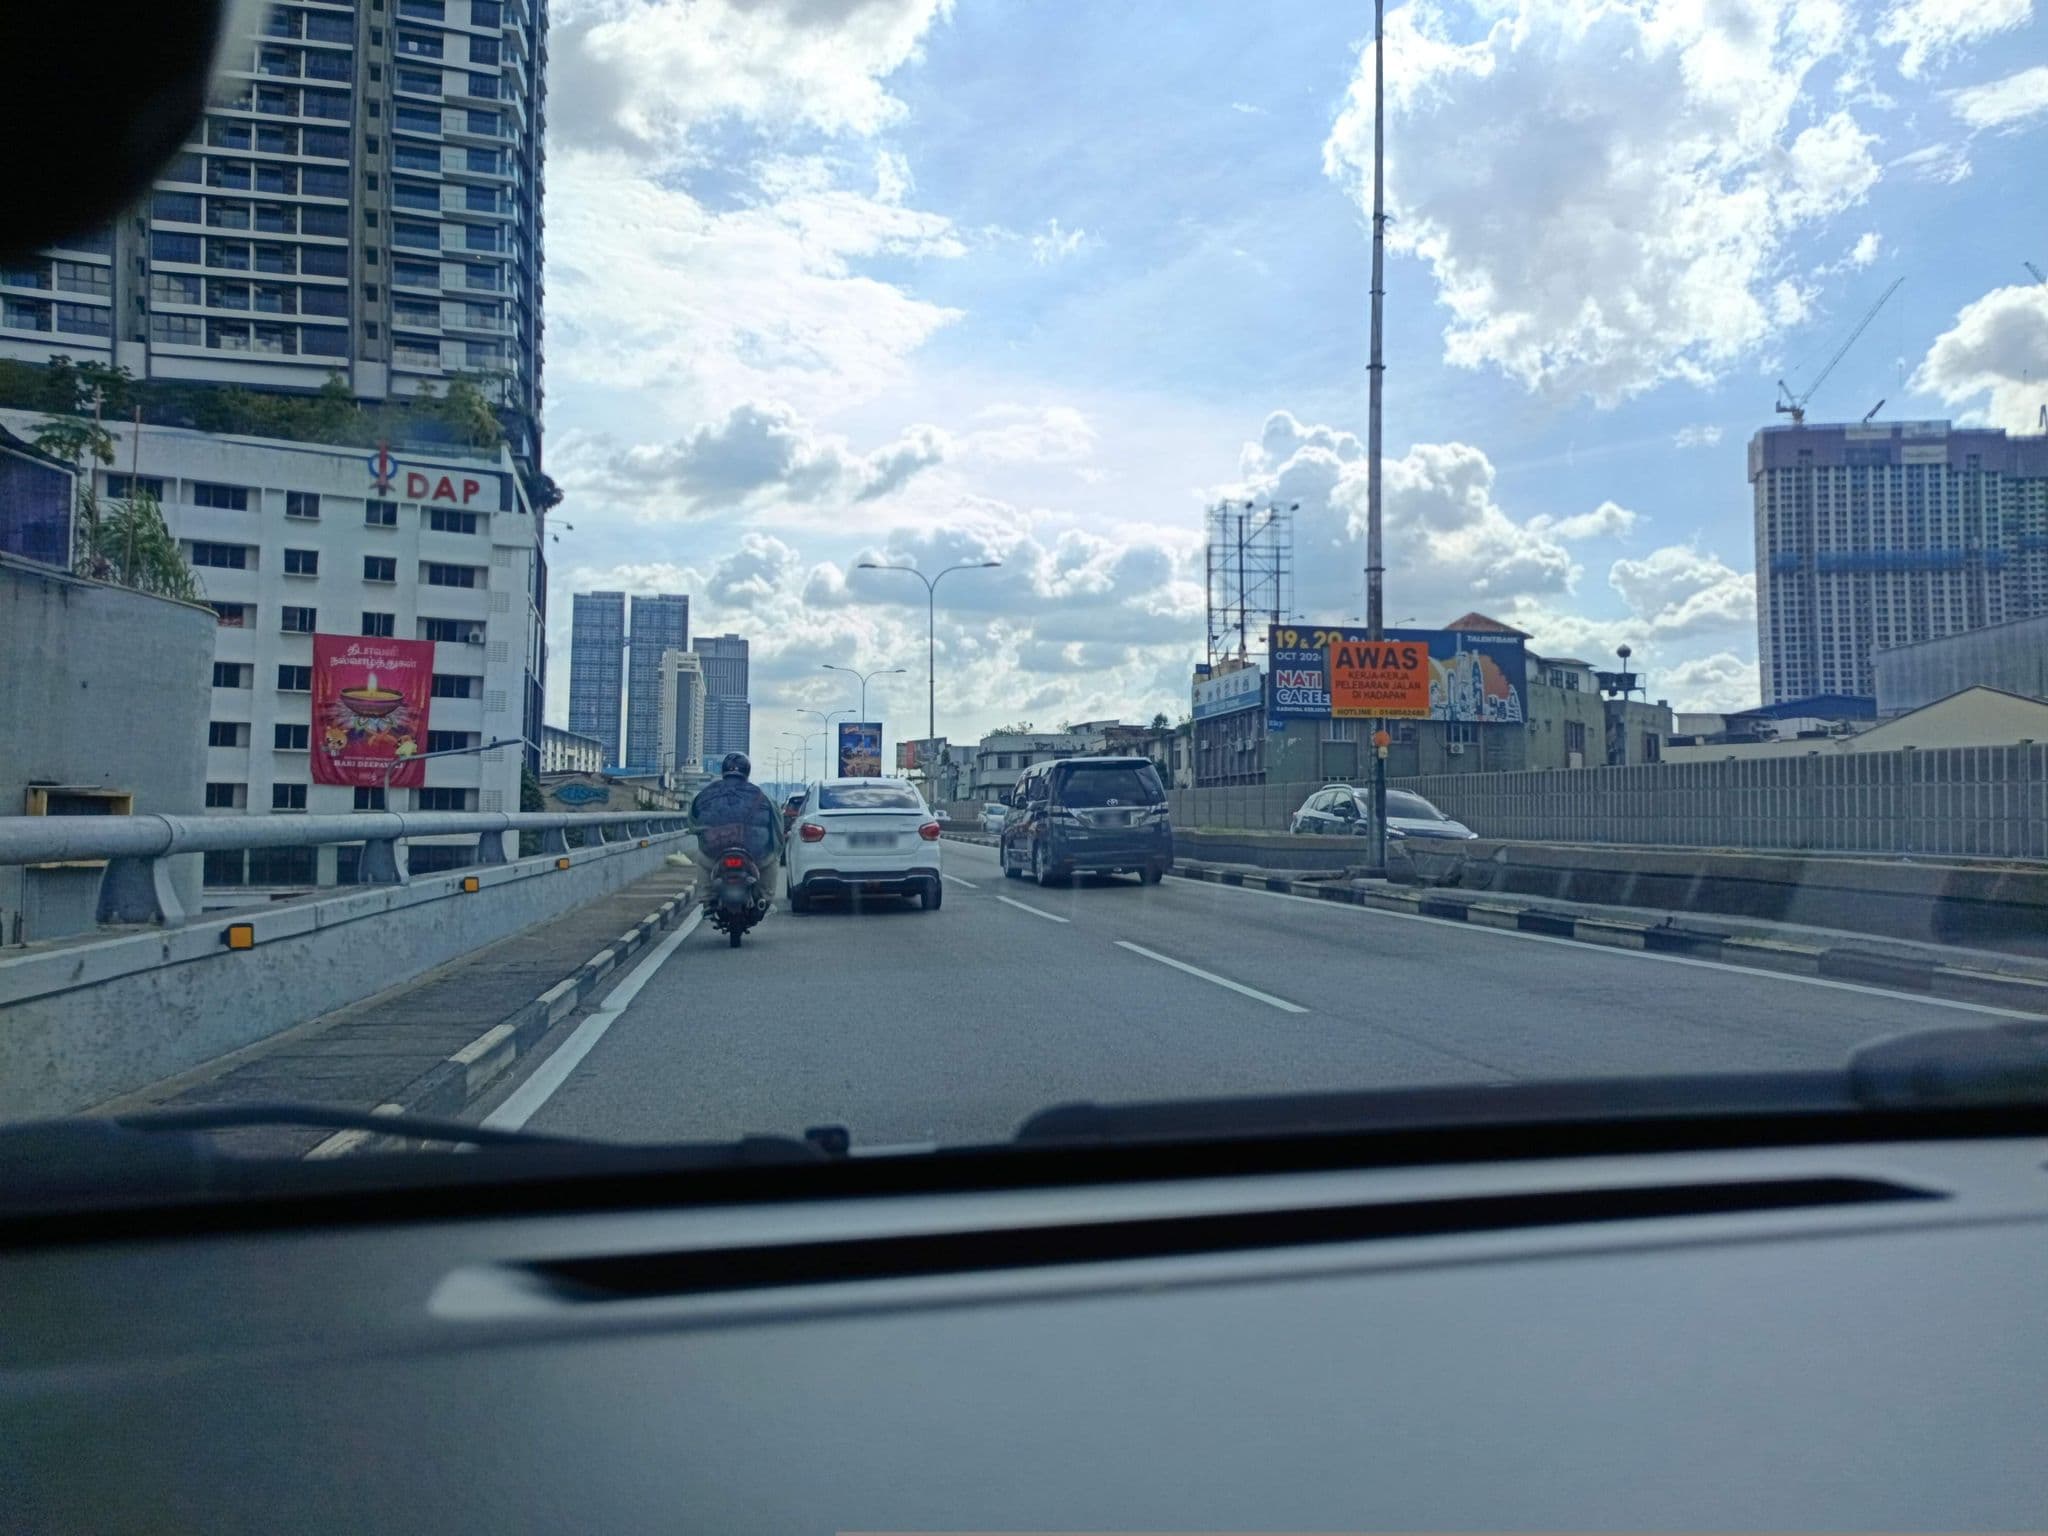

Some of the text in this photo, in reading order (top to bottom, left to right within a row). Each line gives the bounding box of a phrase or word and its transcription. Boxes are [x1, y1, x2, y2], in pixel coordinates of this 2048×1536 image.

[407, 471, 481, 505] DAP
[1275, 629, 1298, 649] 19
[1300, 638, 1309, 649] &
[1313, 630, 1343, 649] 20
[1275, 651, 1322, 661] OCT 202
[1336, 647, 1419, 670] AWAS
[1348, 671, 1409, 680] KERJA-KERJA
[1335, 681, 1421, 690] PELEBARAN JALAN
[1352, 690, 1407, 699] DI HADAPAN
[1337, 708, 1371, 716] HOTLINE
